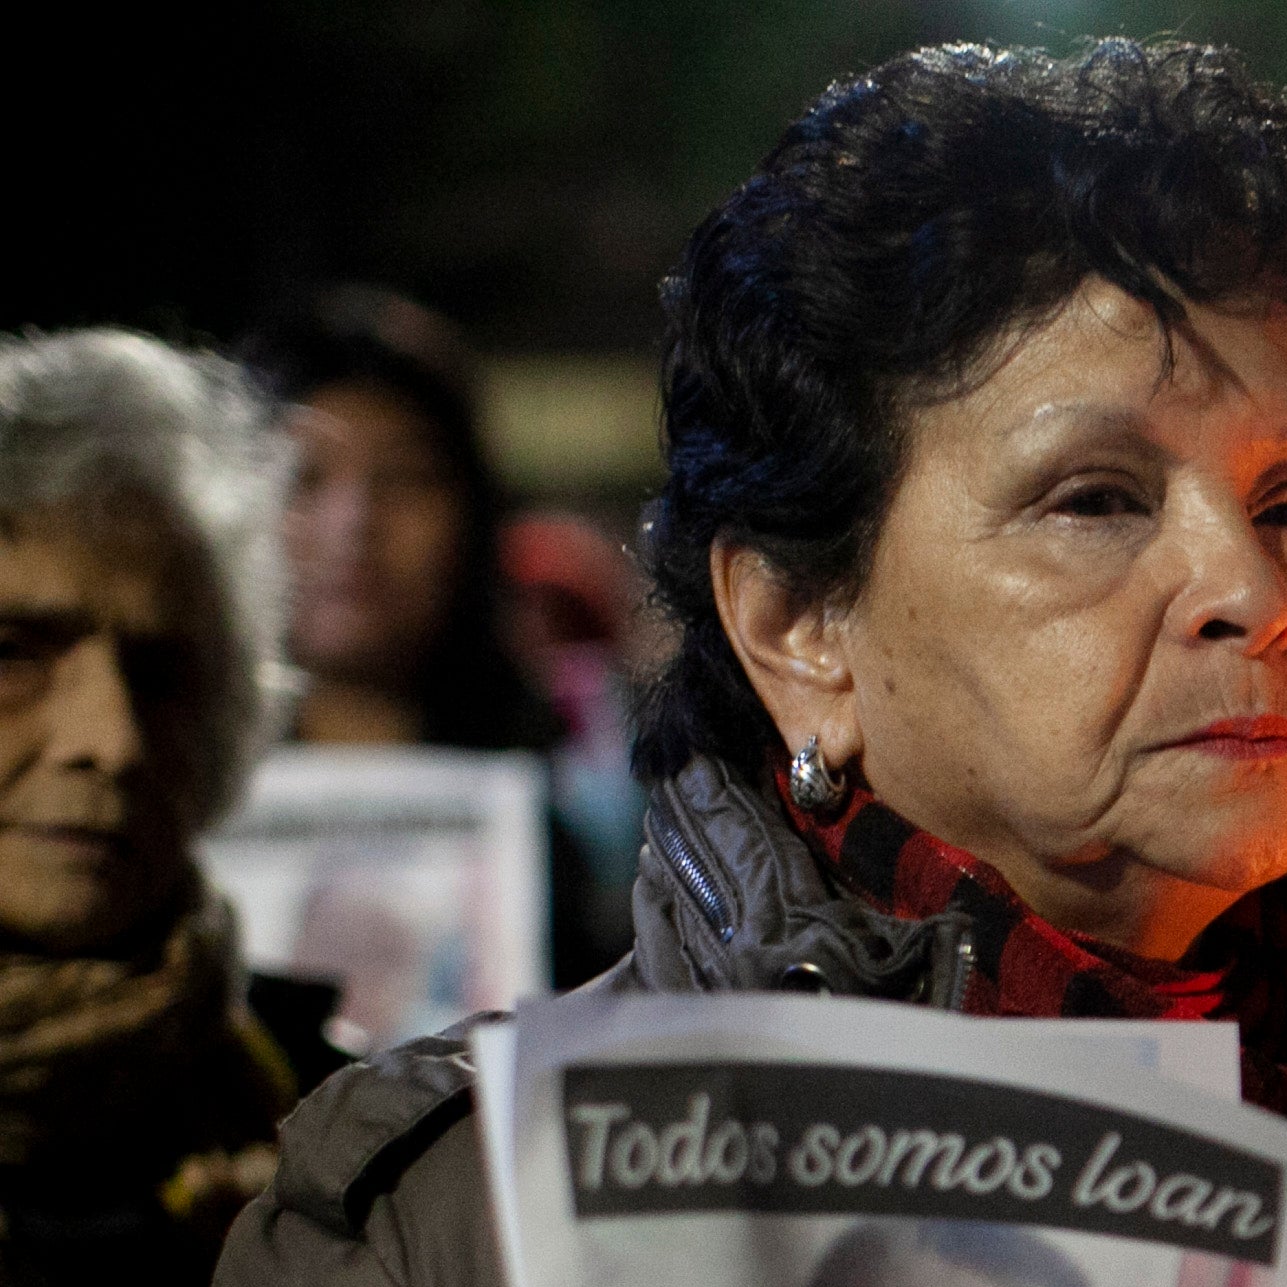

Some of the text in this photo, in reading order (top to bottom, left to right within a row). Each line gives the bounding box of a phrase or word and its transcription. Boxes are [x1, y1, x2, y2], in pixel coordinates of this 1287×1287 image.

[570, 1092, 1277, 1241] Todos somos loan
